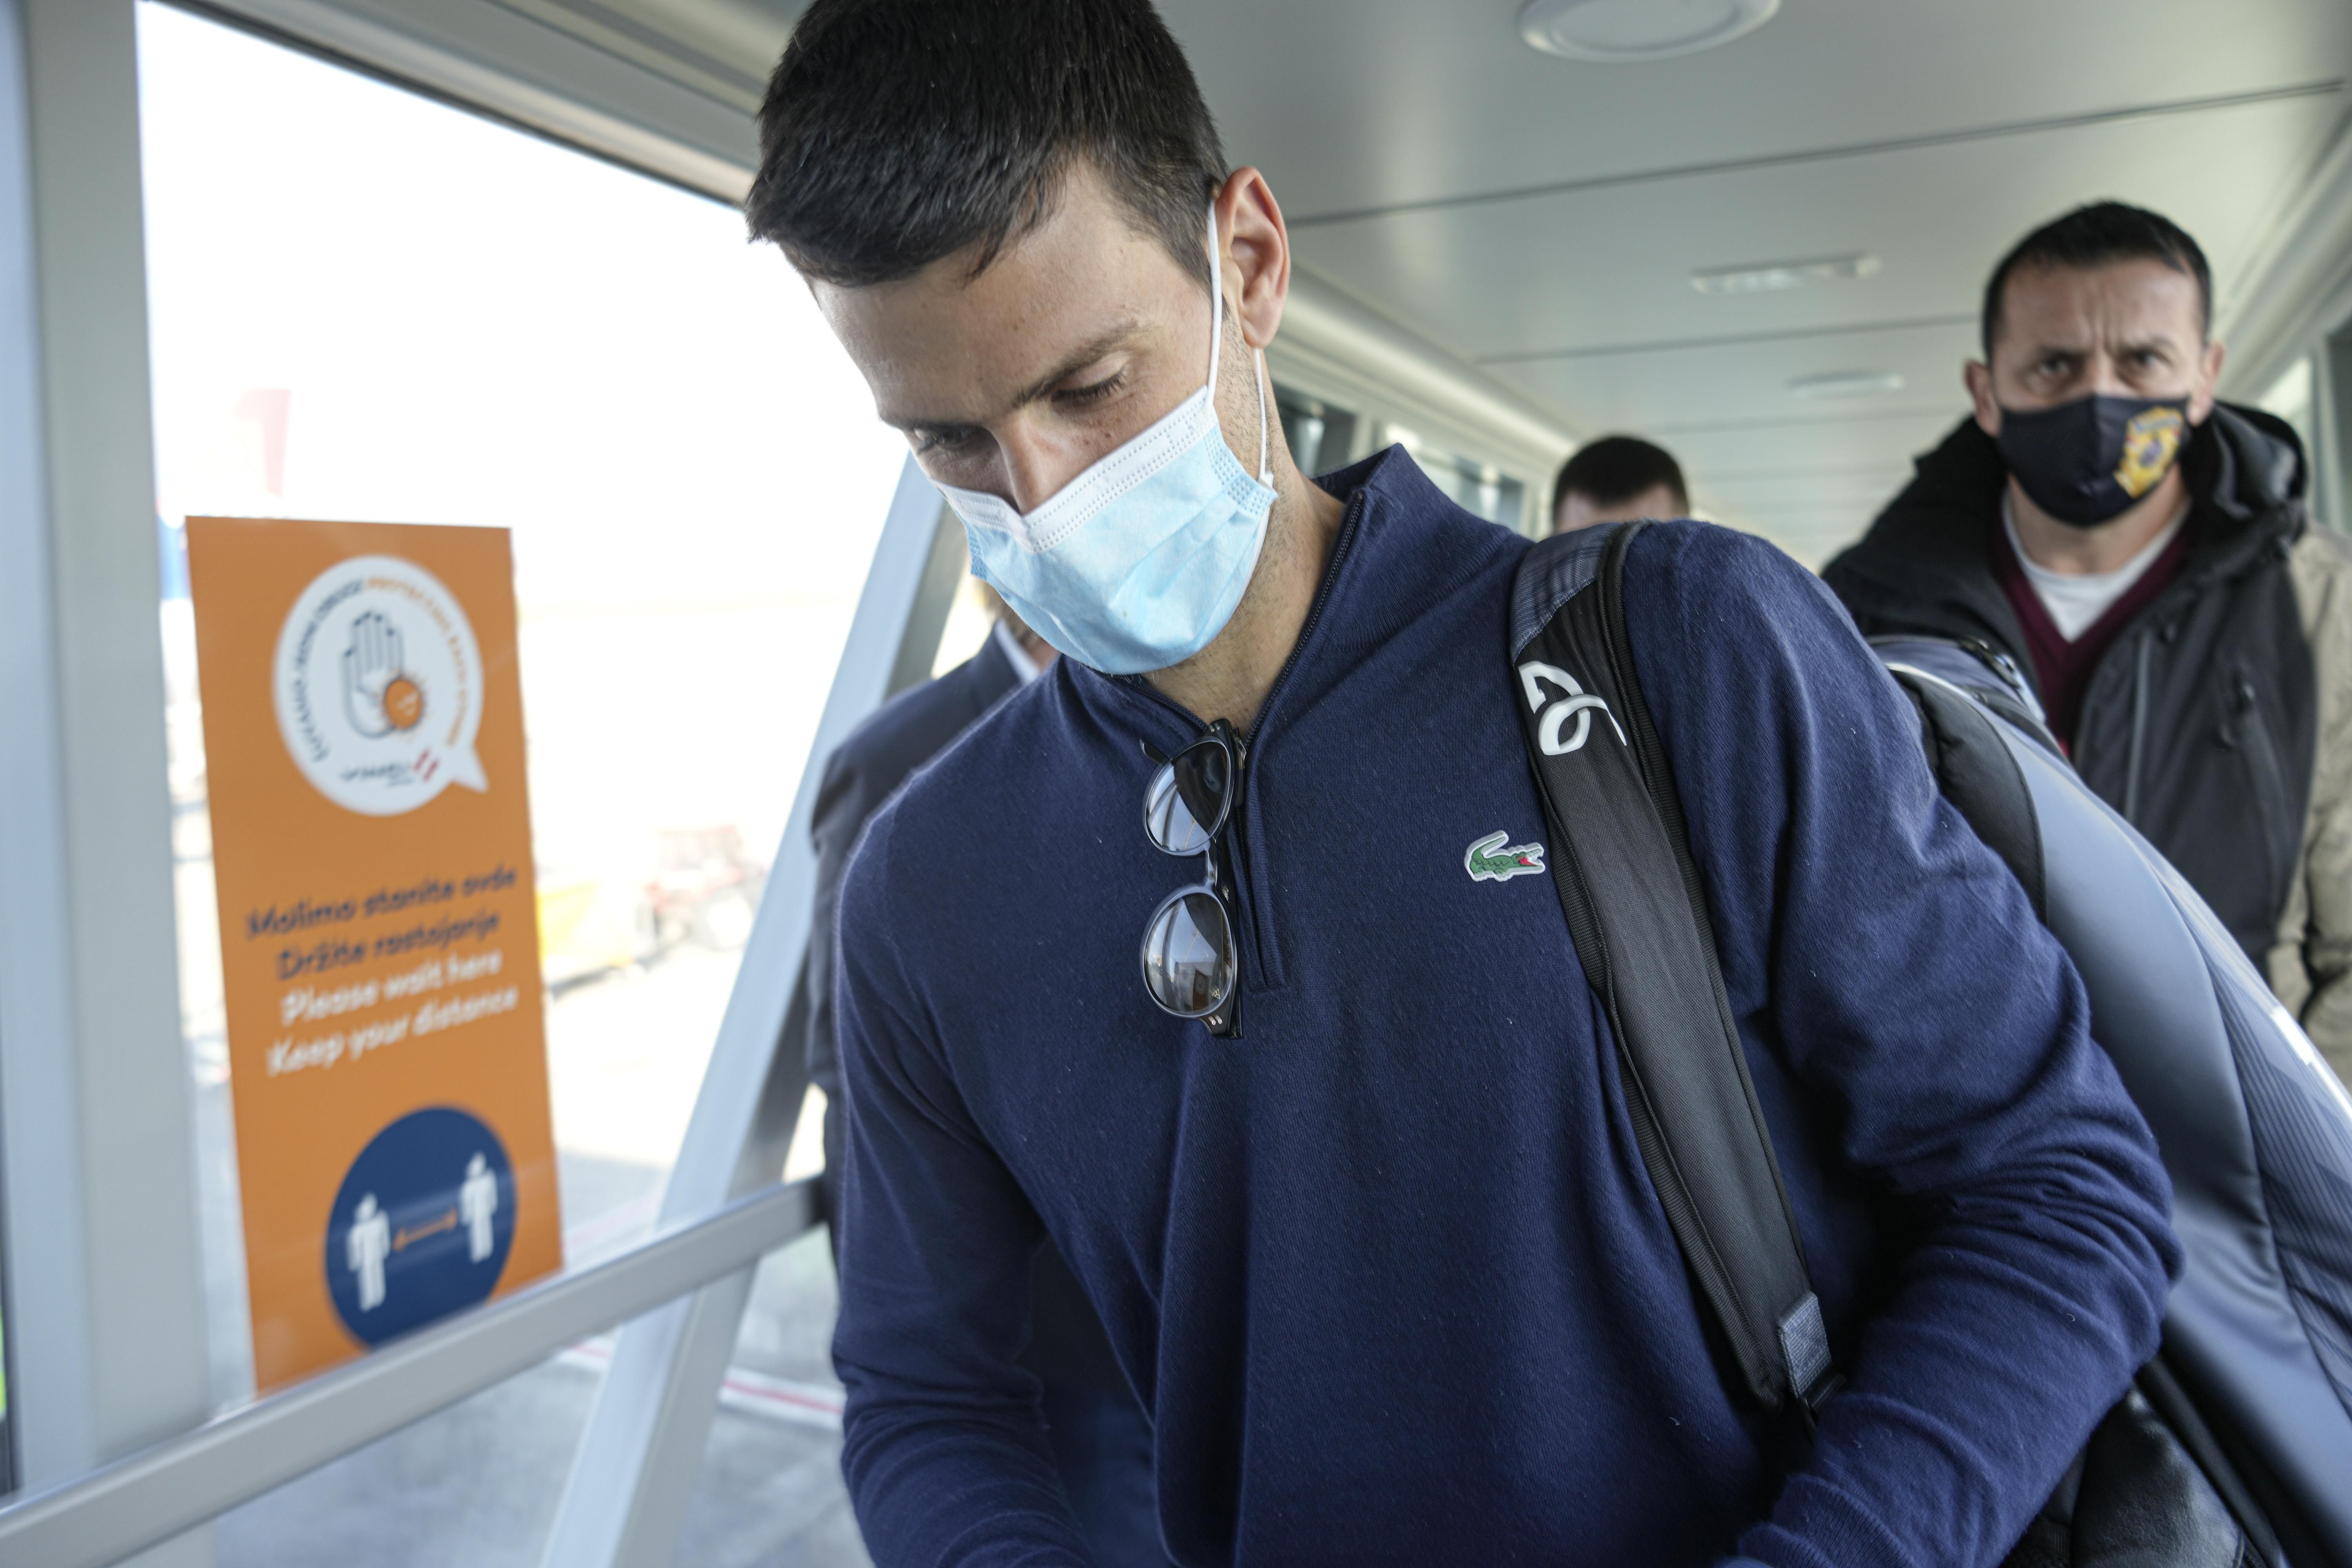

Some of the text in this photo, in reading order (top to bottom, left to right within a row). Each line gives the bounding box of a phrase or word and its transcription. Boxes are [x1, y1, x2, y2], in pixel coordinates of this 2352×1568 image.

[281, 948, 502, 1028] Please wait here
[267, 986, 519, 1077] Keep your distance
